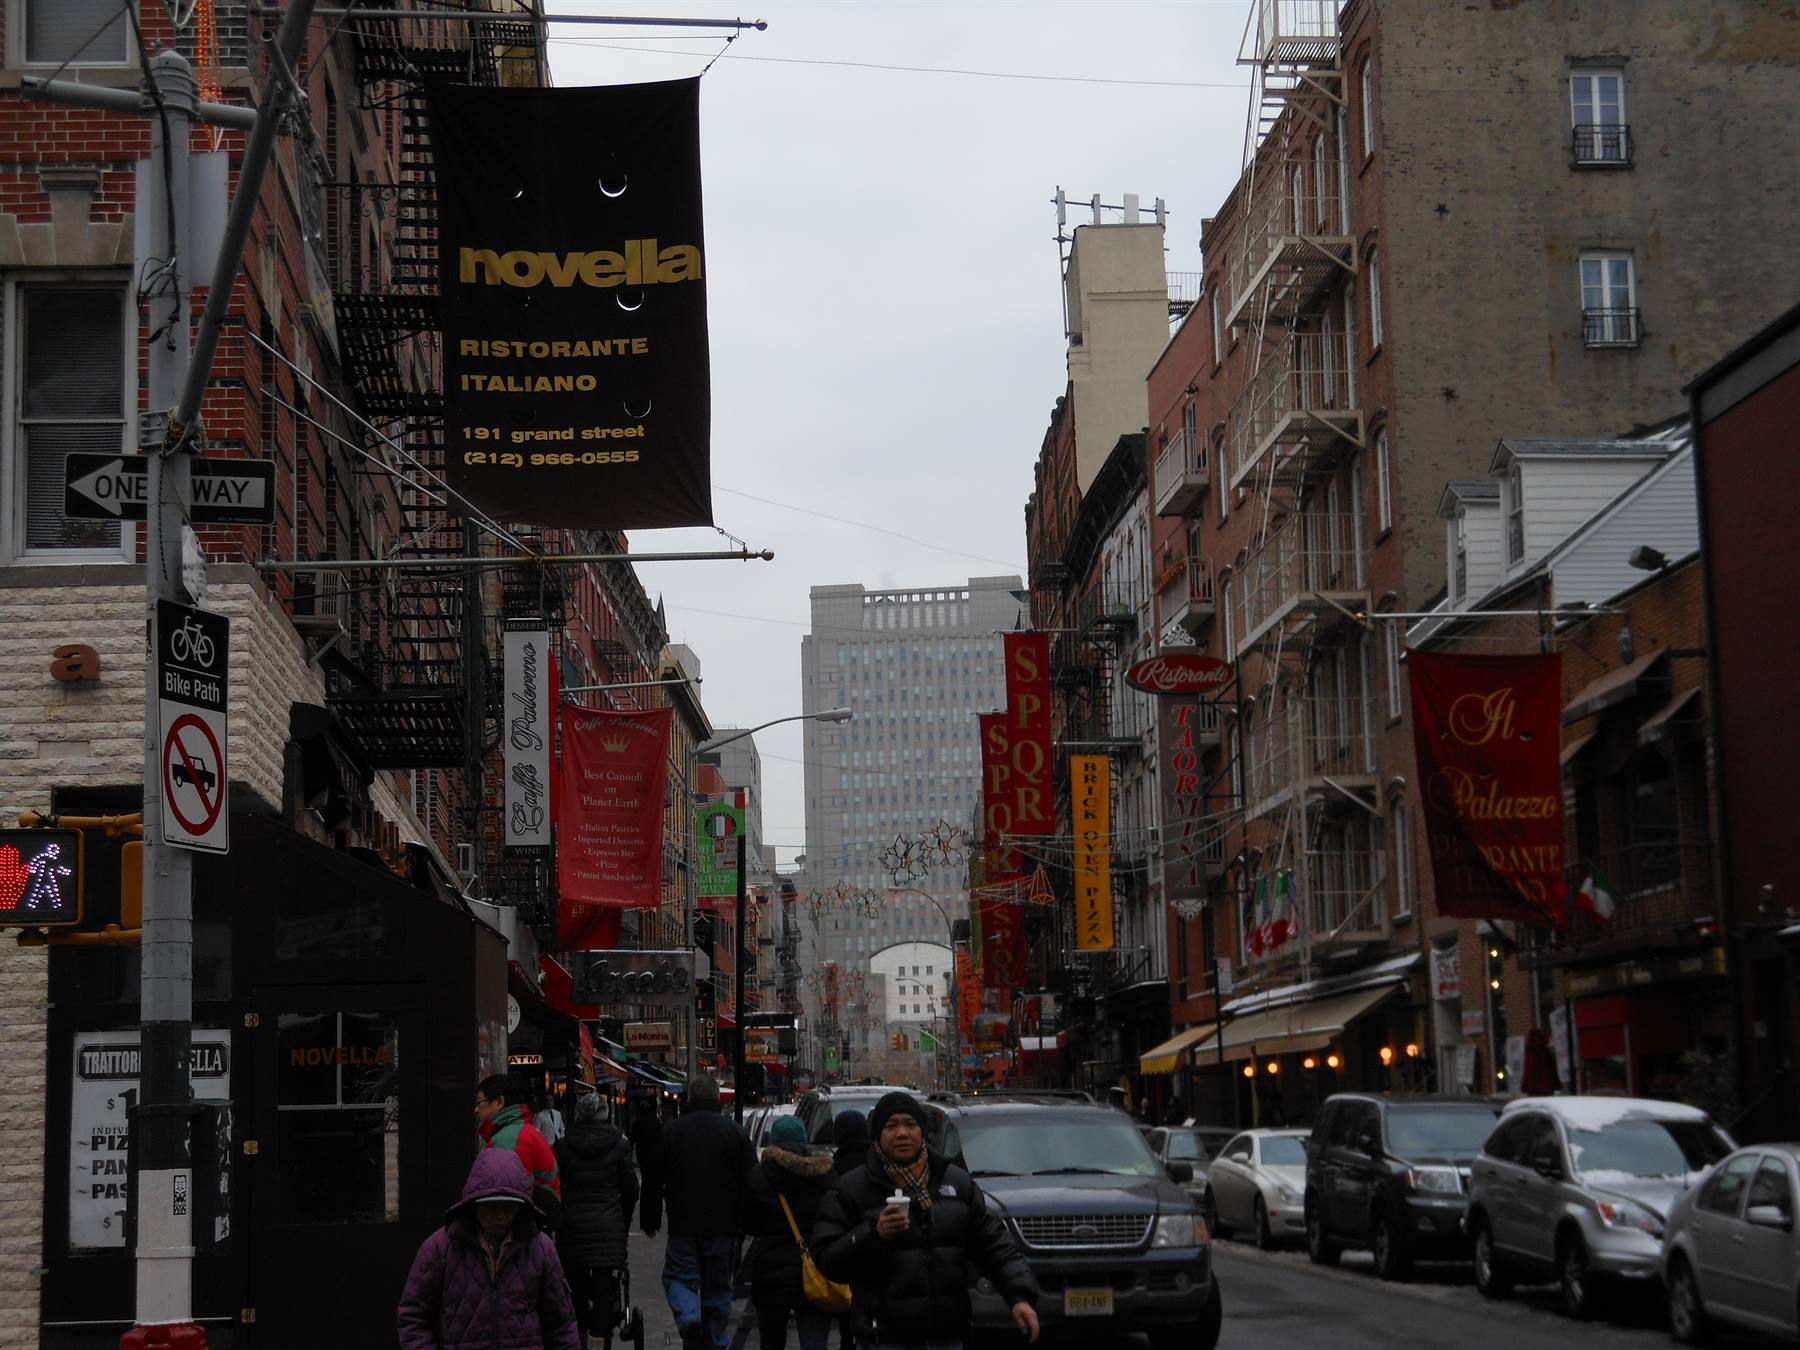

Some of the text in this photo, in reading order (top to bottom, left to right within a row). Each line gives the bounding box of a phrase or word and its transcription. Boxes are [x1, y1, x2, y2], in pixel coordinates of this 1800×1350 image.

[460, 237, 703, 288] novella
[460, 337, 649, 358] RISTORANTE
[460, 374, 598, 393] ITALIANO
[463, 424, 646, 444] 191 grand street
[463, 450, 641, 468] (212) 966-0555
[95, 474, 250, 504] ONE WAY
[505, 621, 546, 630] DESSERTS
[1136, 659, 1229, 690] Ristorante
[165, 672, 220, 704] Bike Path
[510, 642, 543, 751] Palermo
[583, 769, 642, 782] Best Cannoli
[1169, 703, 1201, 888] TAORMINA
[1427, 764, 1558, 821] Palazzo
[583, 796, 640, 809] Planet Earth
[585, 823, 609, 832] Italian
[577, 834, 611, 845] Imported
[588, 847, 635, 858] Espresso Bar
[1082, 762, 1100, 944] BRICK OVEN PIZZA
[600, 860, 619, 869] Pizza
[577, 871, 644, 882] Panini Sandwiches
[626, 1032, 637, 1041] La
[289, 1045, 389, 1067] NOVELLA
[509, 1055, 539, 1064] ATM
